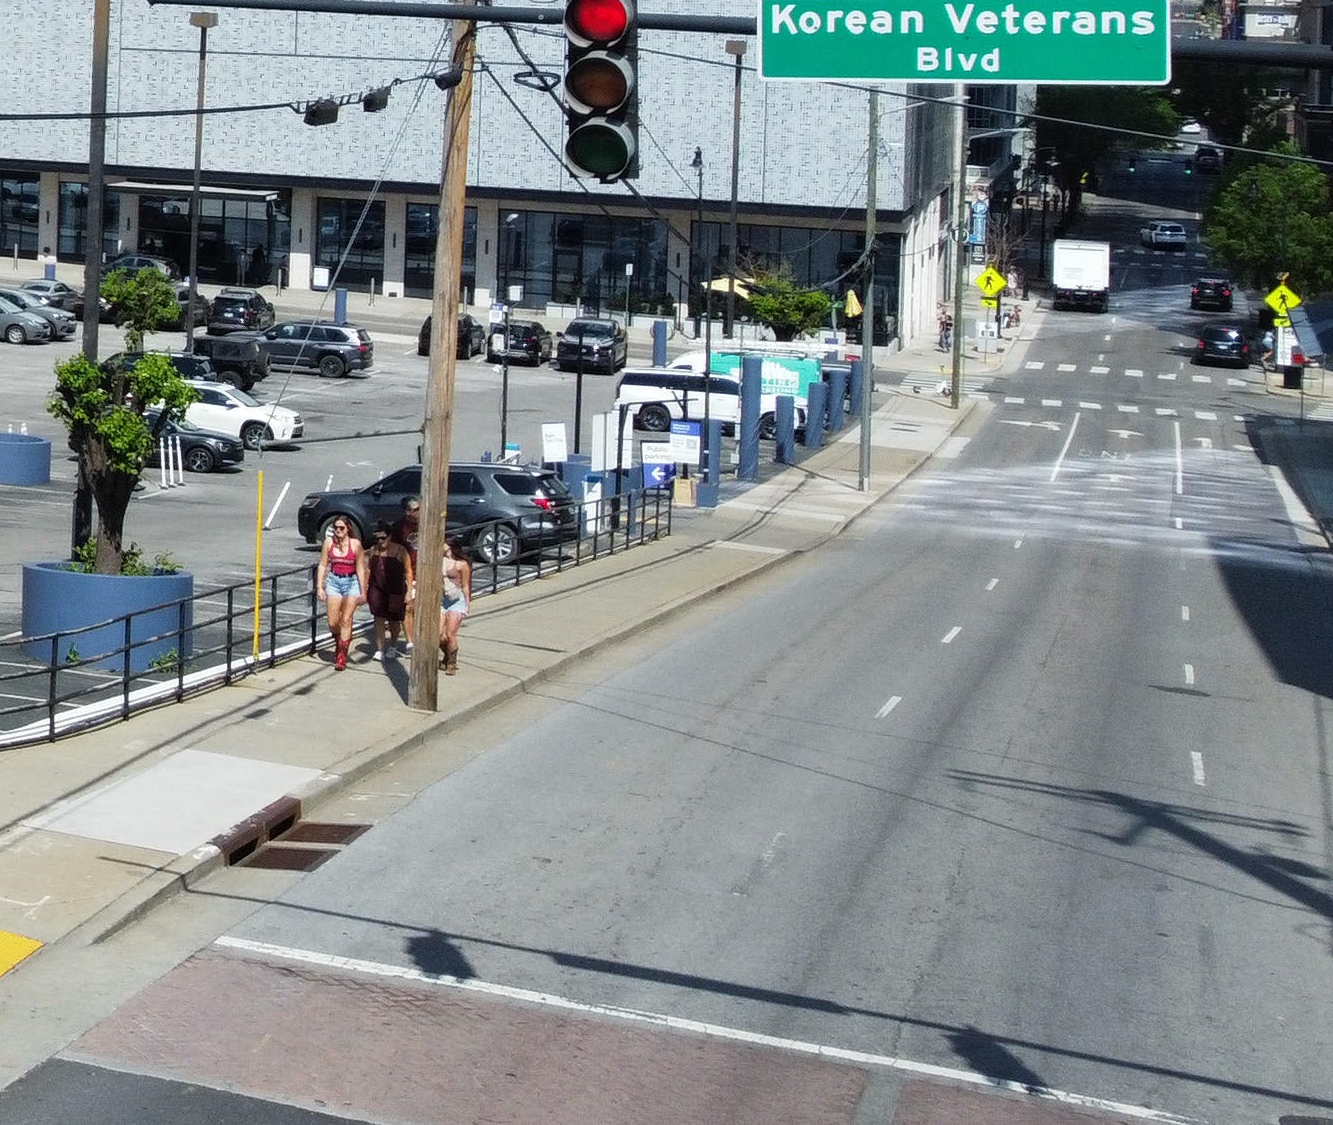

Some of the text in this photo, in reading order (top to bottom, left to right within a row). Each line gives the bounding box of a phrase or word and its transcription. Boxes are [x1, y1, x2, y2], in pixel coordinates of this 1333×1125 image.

[771, 3, 1156, 35] Korean Veterans
[916, 46, 1001, 73] Blvd
